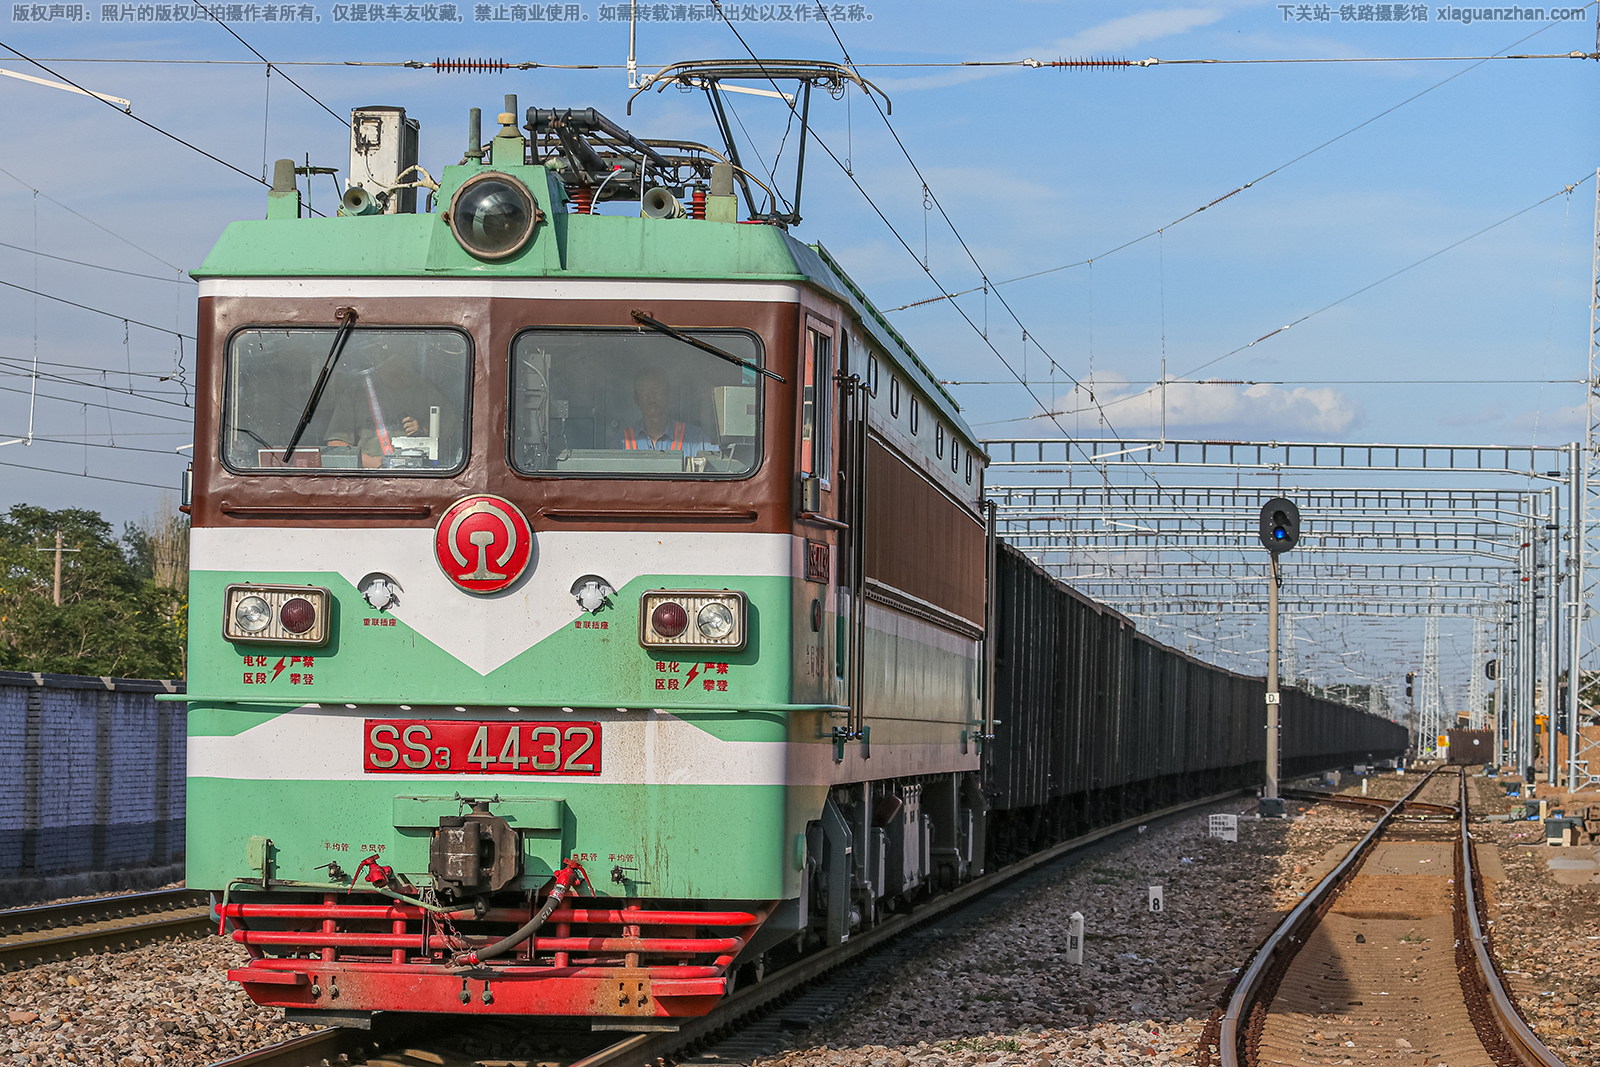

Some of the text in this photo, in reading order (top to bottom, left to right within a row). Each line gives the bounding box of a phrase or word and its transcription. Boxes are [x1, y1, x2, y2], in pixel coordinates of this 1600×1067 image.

[363, 618, 397, 627] 重联插座
[574, 621, 608, 630] 重联插座
[243, 655, 267, 667] 电化
[290, 656, 314, 667] 严禁
[655, 660, 680, 673] 电化
[703, 661, 729, 675] 严禁
[243, 672, 267, 684] 区段
[290, 673, 314, 685] 攀登
[655, 678, 680, 691] 区段
[703, 679, 729, 692] 攀登
[467, 726, 595, 771] 4432
[1152, 897, 1160, 910] 8
